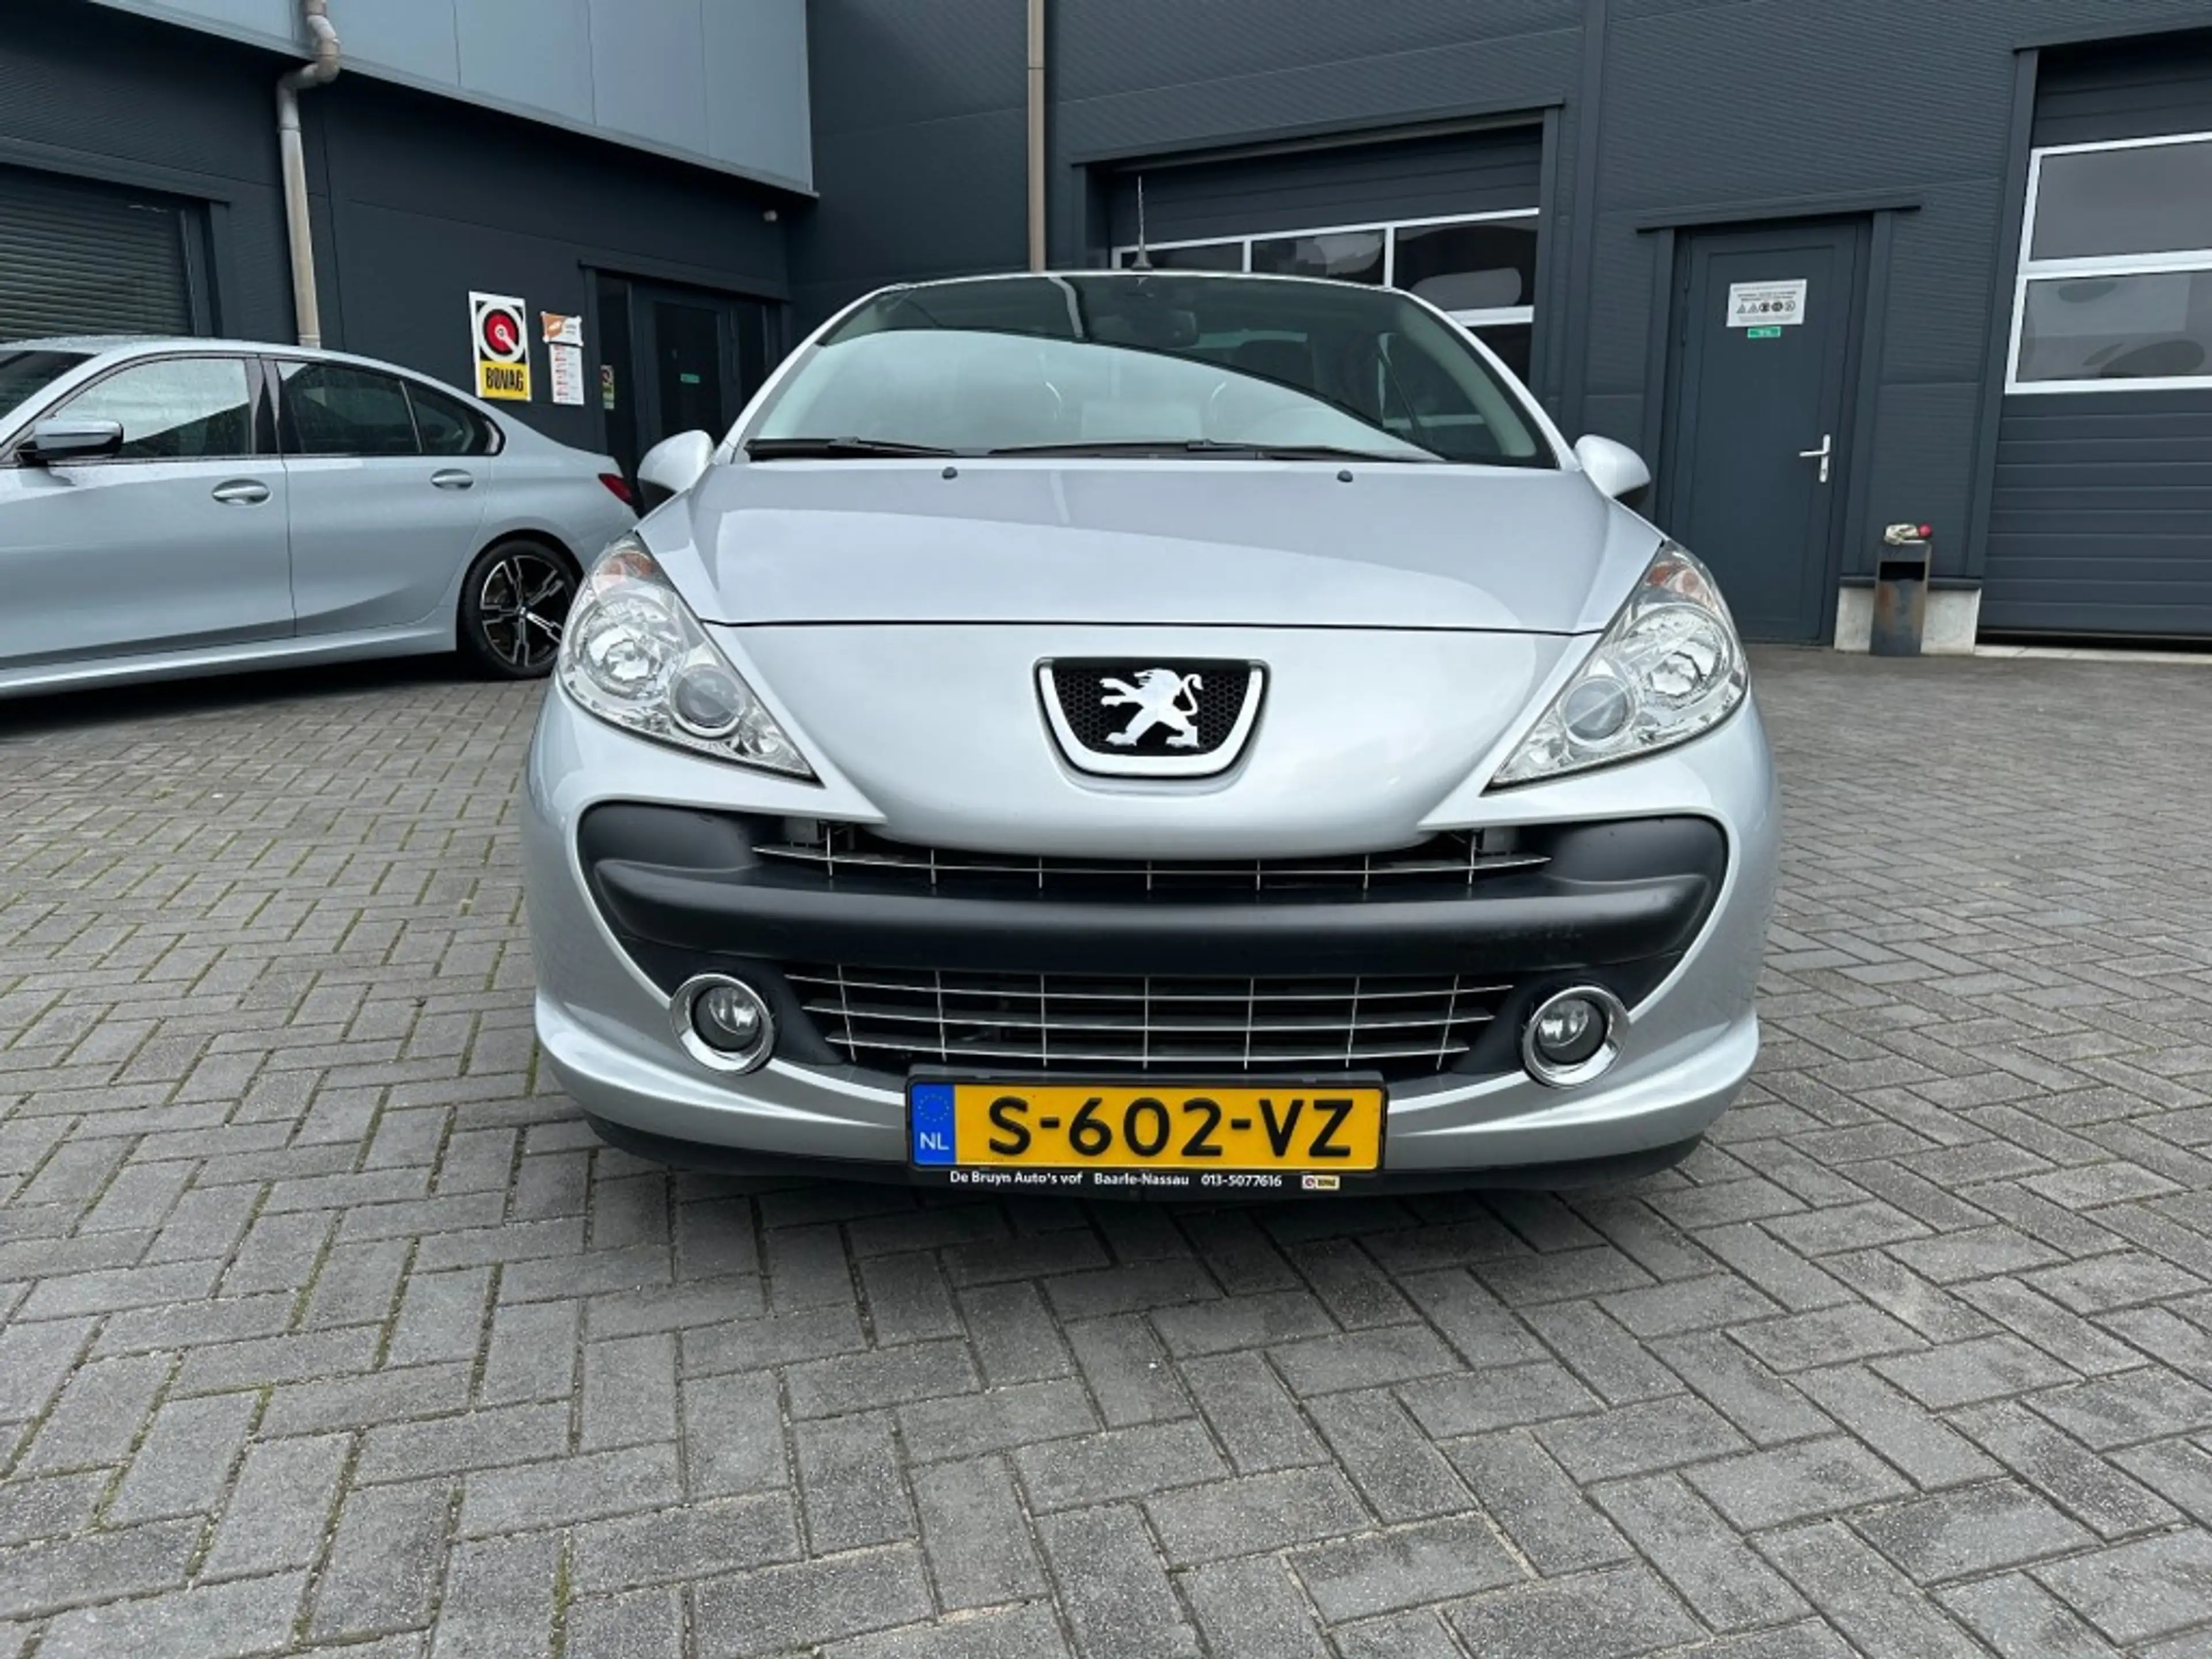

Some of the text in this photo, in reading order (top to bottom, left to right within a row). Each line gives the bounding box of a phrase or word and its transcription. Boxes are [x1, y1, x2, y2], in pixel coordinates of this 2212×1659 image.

[485, 367, 524, 392] BOVAG
[988, 1096, 1354, 1157] S-602-VZ
[919, 1132, 949, 1150] NL
[950, 1171, 1283, 1187] De Bruyn Auto's vof Baarle-Nassau 013-5077616
